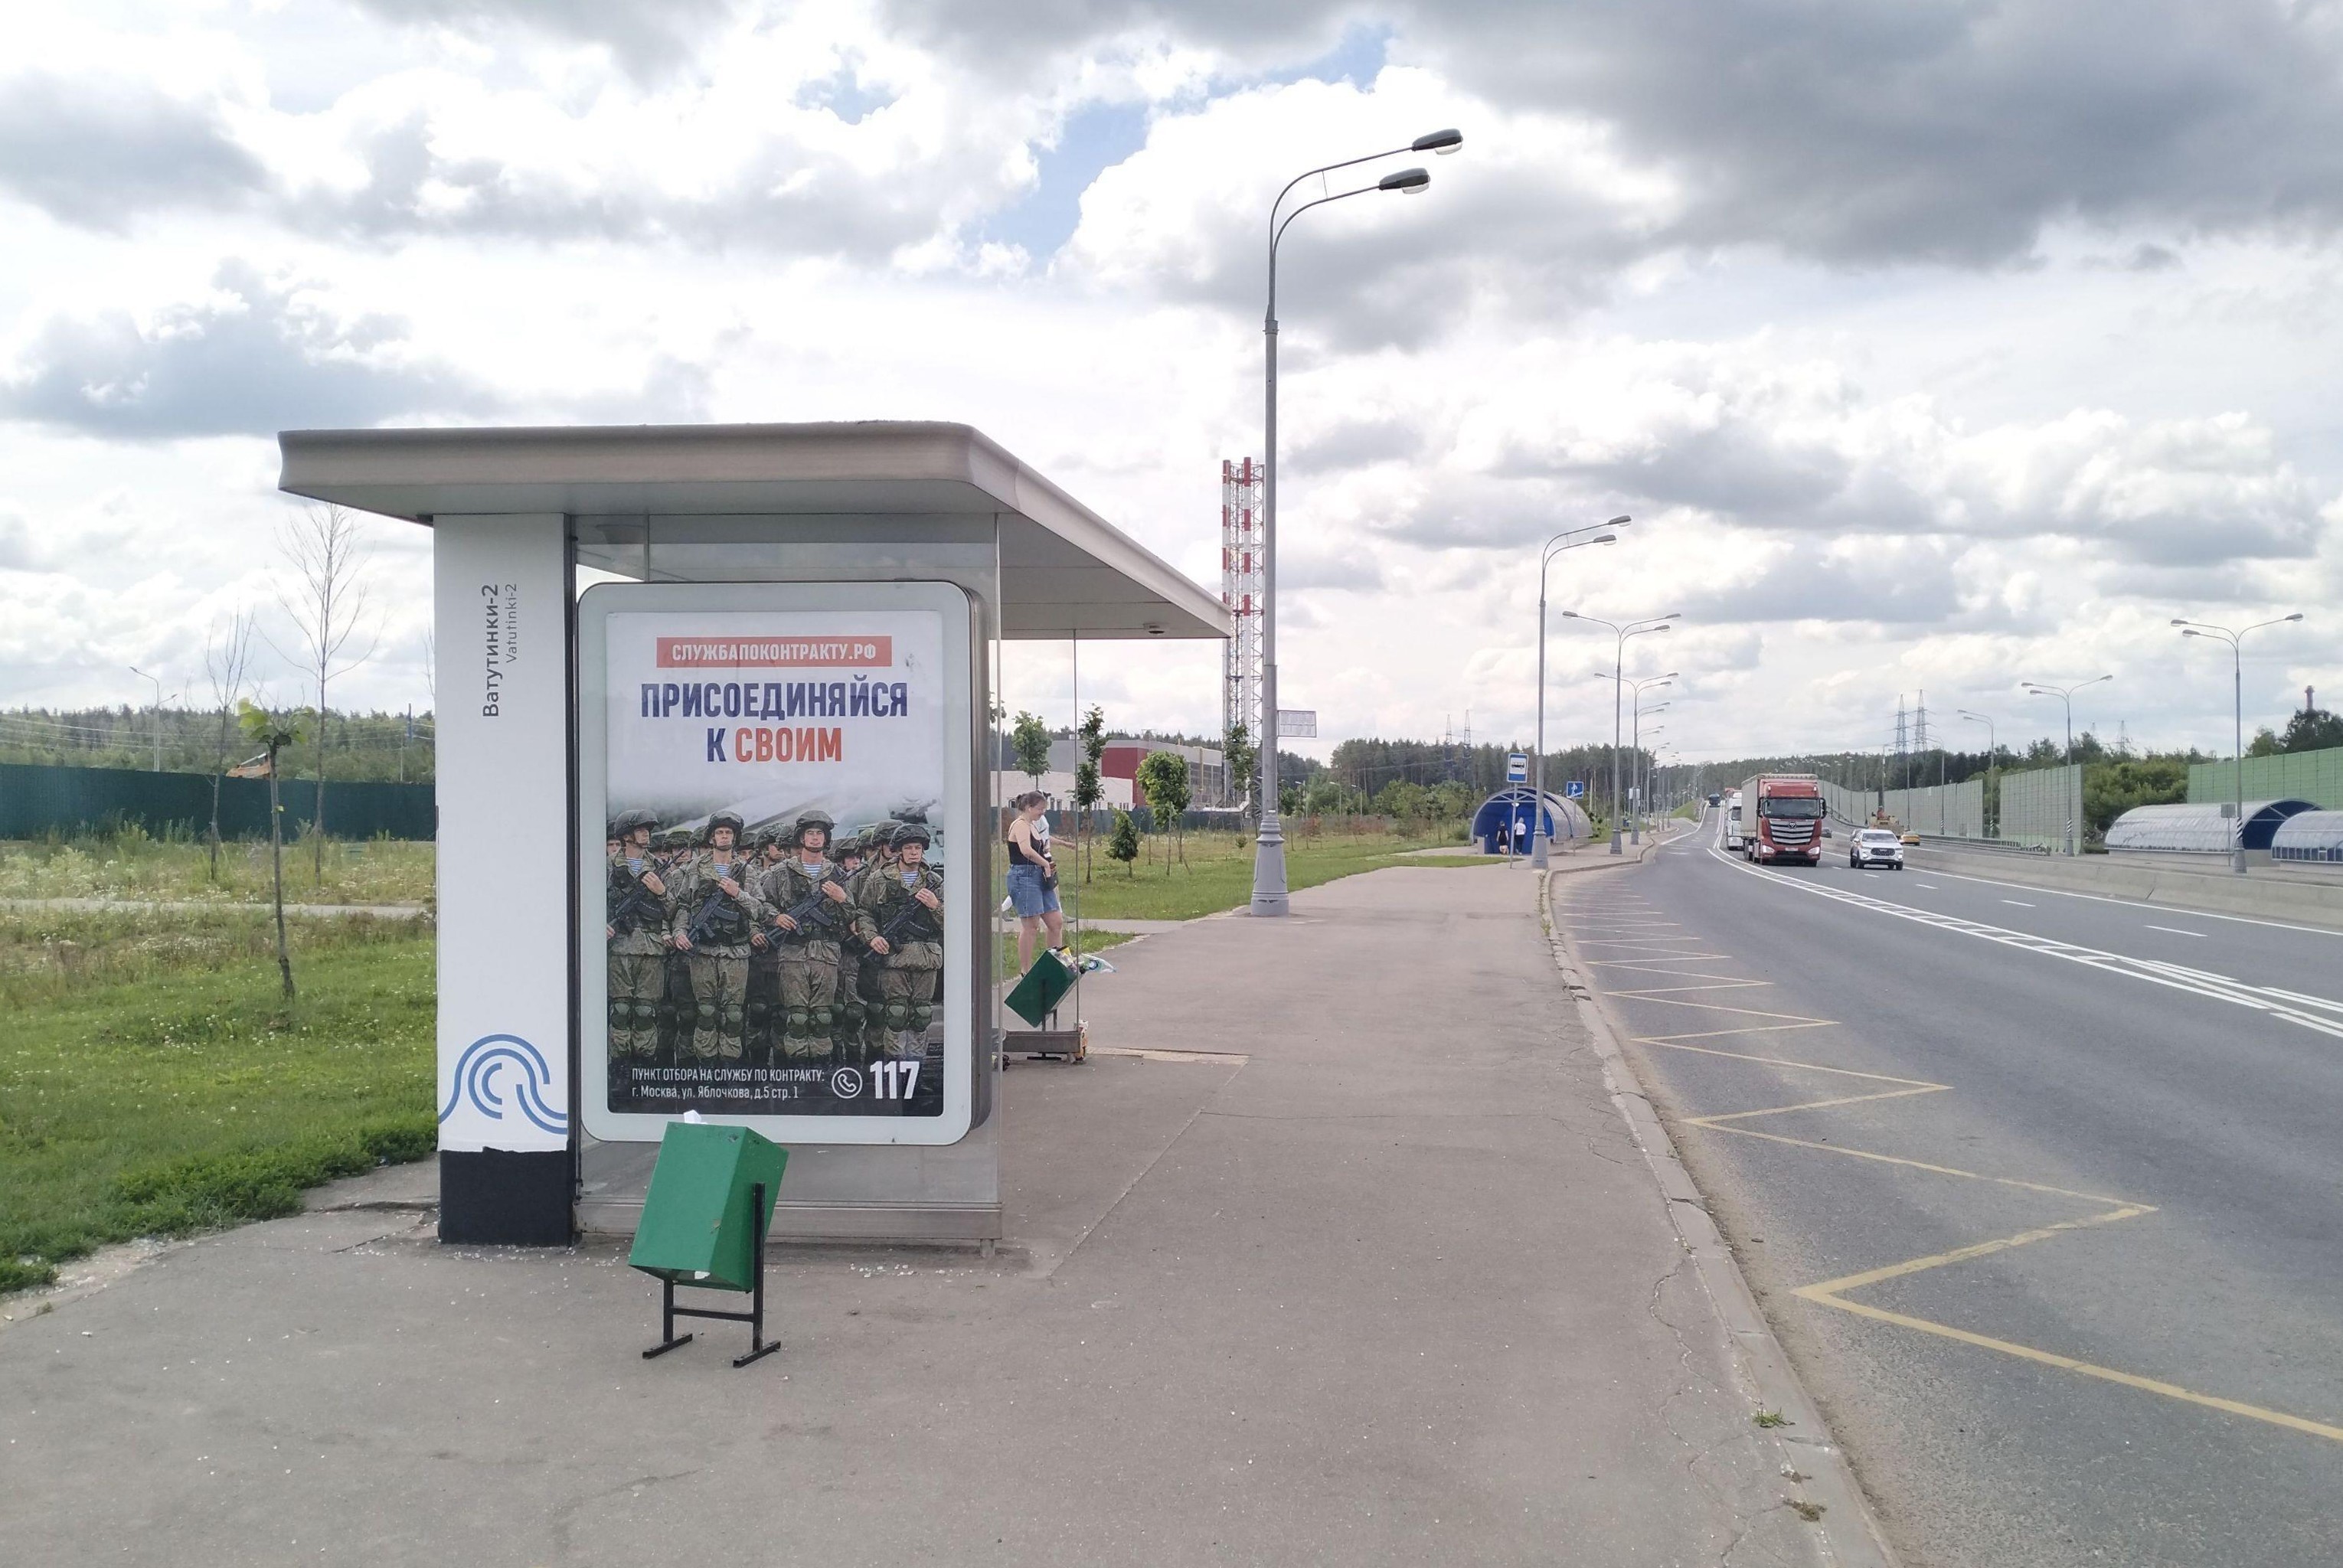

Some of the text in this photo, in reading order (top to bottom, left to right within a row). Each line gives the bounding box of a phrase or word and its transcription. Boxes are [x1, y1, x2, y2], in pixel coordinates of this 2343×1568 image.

[505, 583, 518, 663] Vatutinki-2
[482, 584, 502, 717] Ватутинки-2
[672, 642, 877, 661] СЛУЖБАПОКОНТРАКТУ.РФ
[641, 674, 907, 720] ПРИСОЕДИНЯЙСЯ
[707, 727, 842, 762] К СВОИМ
[632, 1068, 825, 1082] ПУНКТ ОТБОРА НА СЛУЖБУ ПО КОНТРАКТУ:
[632, 1087, 639, 1097] г.
[641, 1085, 680, 1099] Москва,
[681, 1087, 695, 1100] ул.
[698, 1086, 753, 1099] Яблочкова,
[771, 1088, 791, 1101] стр.
[793, 1086, 799, 1099] 1
[869, 1061, 920, 1099] 117
